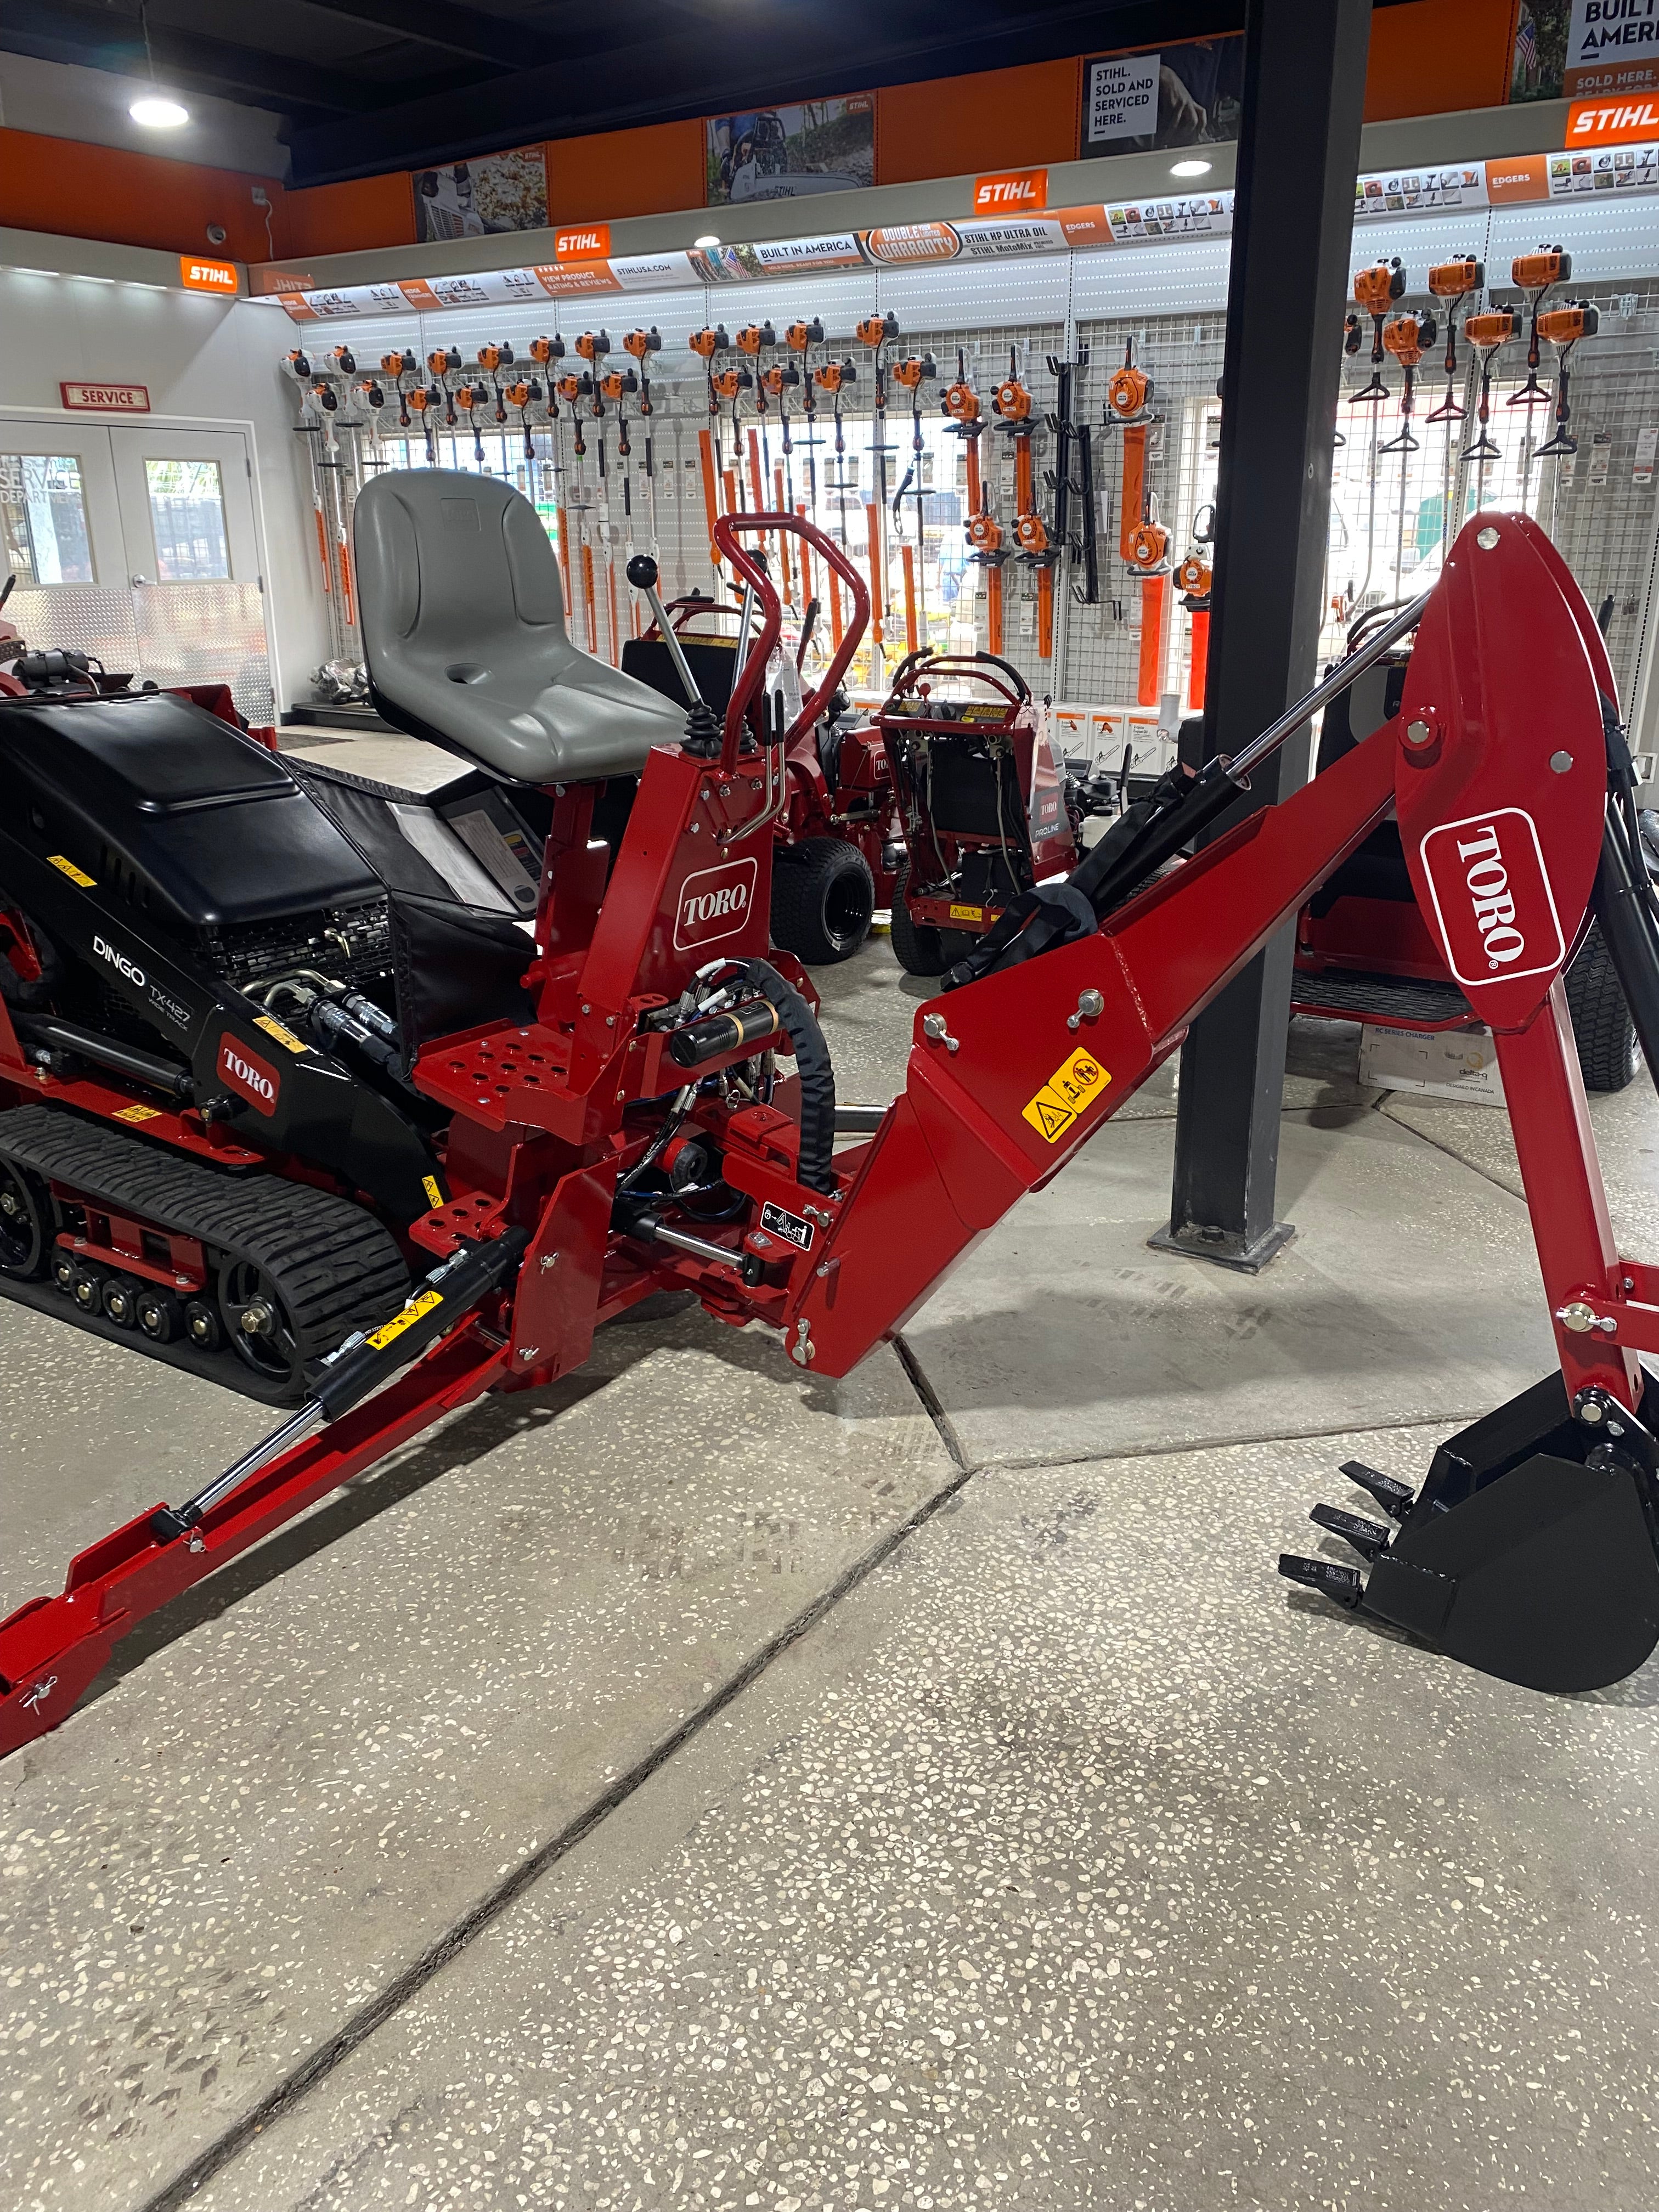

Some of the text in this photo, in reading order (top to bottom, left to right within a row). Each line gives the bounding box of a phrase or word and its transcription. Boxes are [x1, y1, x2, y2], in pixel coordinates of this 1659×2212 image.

[1585, 0, 1656, 22] BUILT
[1097, 66, 1131, 81] STIHL.
[1576, 70, 1657, 89] SOLD HERE.
[1096, 78, 1153, 96] SOLD AND
[850, 100, 868, 109] STIHL
[1096, 94, 1149, 111] SERVICED
[1094, 112, 1126, 127] HERE.
[1573, 104, 1659, 134] STIHL
[1492, 174, 1530, 184] EDGERS
[977, 180, 1036, 204] STIHL
[882, 225, 919, 241] DOUBLE
[1066, 222, 1095, 230] EDGERS
[558, 233, 600, 252] STIHL
[964, 227, 1047, 244] STIHL HP ULTRA OIL
[760, 241, 853, 258] BUILT IN AMERICA
[877, 236, 954, 258] WARRANTY
[970, 242, 1034, 255] STIHL MotoMix
[189, 266, 233, 285] STIHL
[562, 272, 595, 281] PRODUCT
[617, 265, 672, 275] STIHLUSA.COM
[547, 281, 573, 290] RATING
[580, 278, 612, 286] REVIEWS
[82, 390, 134, 404] SERVICE
[1041, 802, 1057, 815] TORO
[1035, 823, 1059, 838] PROLINE
[1457, 825, 1524, 962] TORO
[684, 884, 746, 926] TORO
[93, 935, 145, 986] DINGO
[1406, 1031, 1435, 1041] CHARGER
[224, 1048, 273, 1098] TORO
